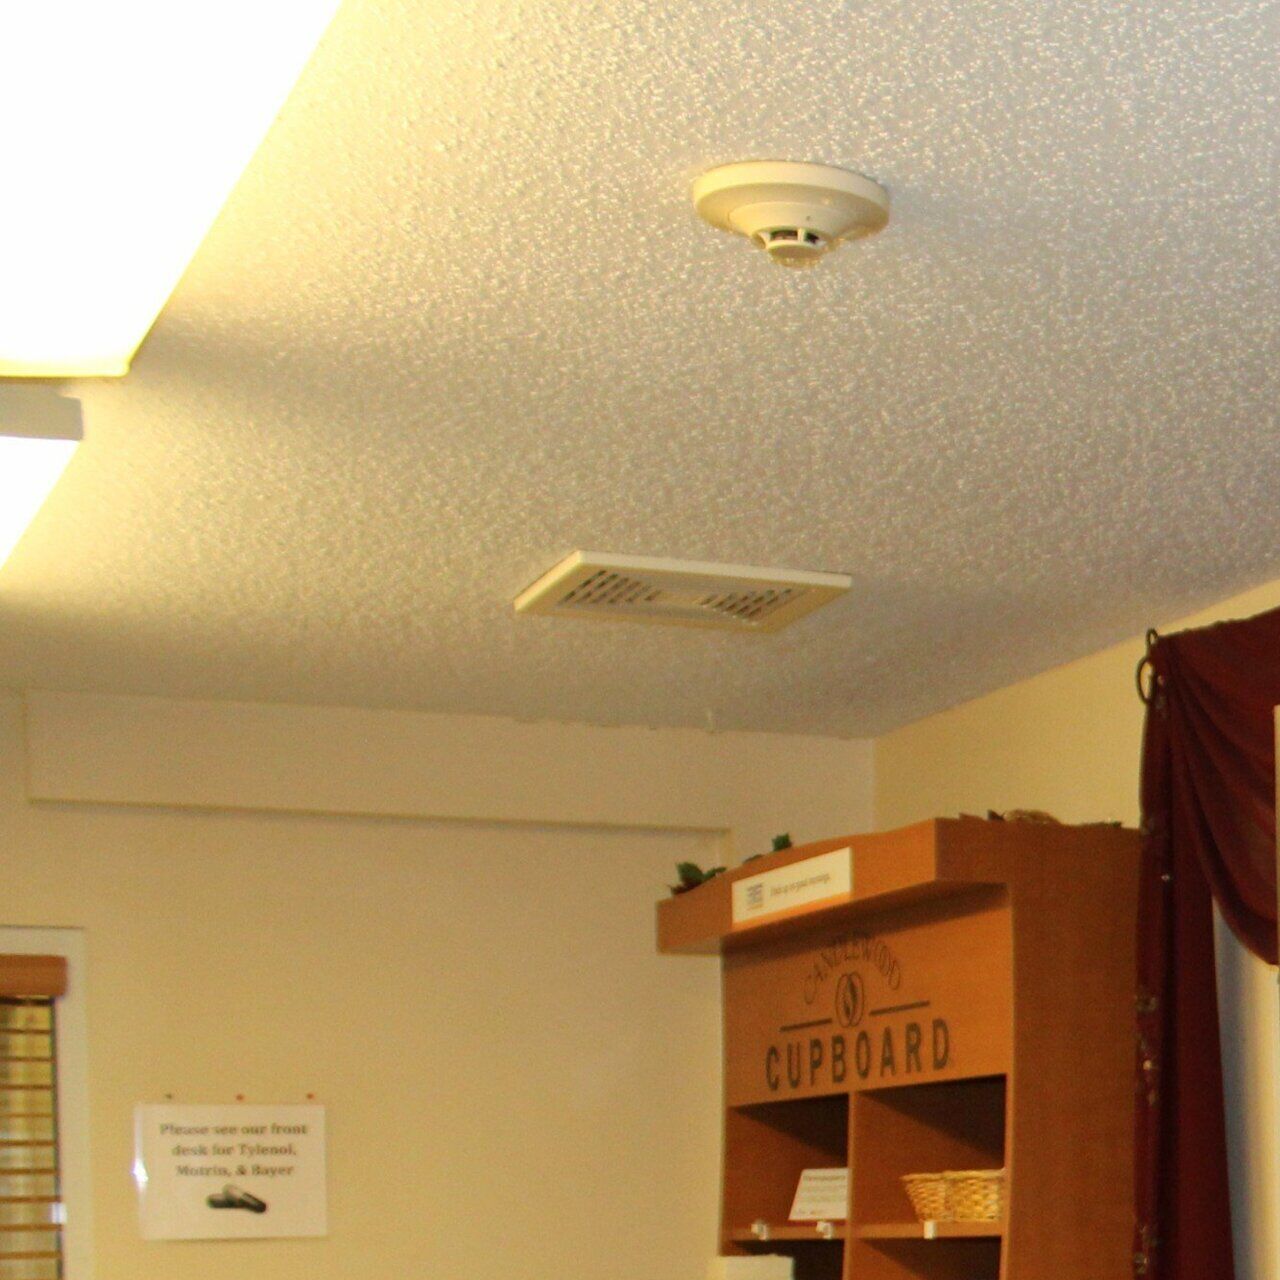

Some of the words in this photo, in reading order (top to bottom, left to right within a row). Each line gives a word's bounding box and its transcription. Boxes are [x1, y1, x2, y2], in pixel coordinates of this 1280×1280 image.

[765, 1018, 951, 1092] CUPBOARD
[160, 1122, 209, 1137] Please
[270, 1122, 308, 1136] front
[172, 1142, 208, 1157] desk
